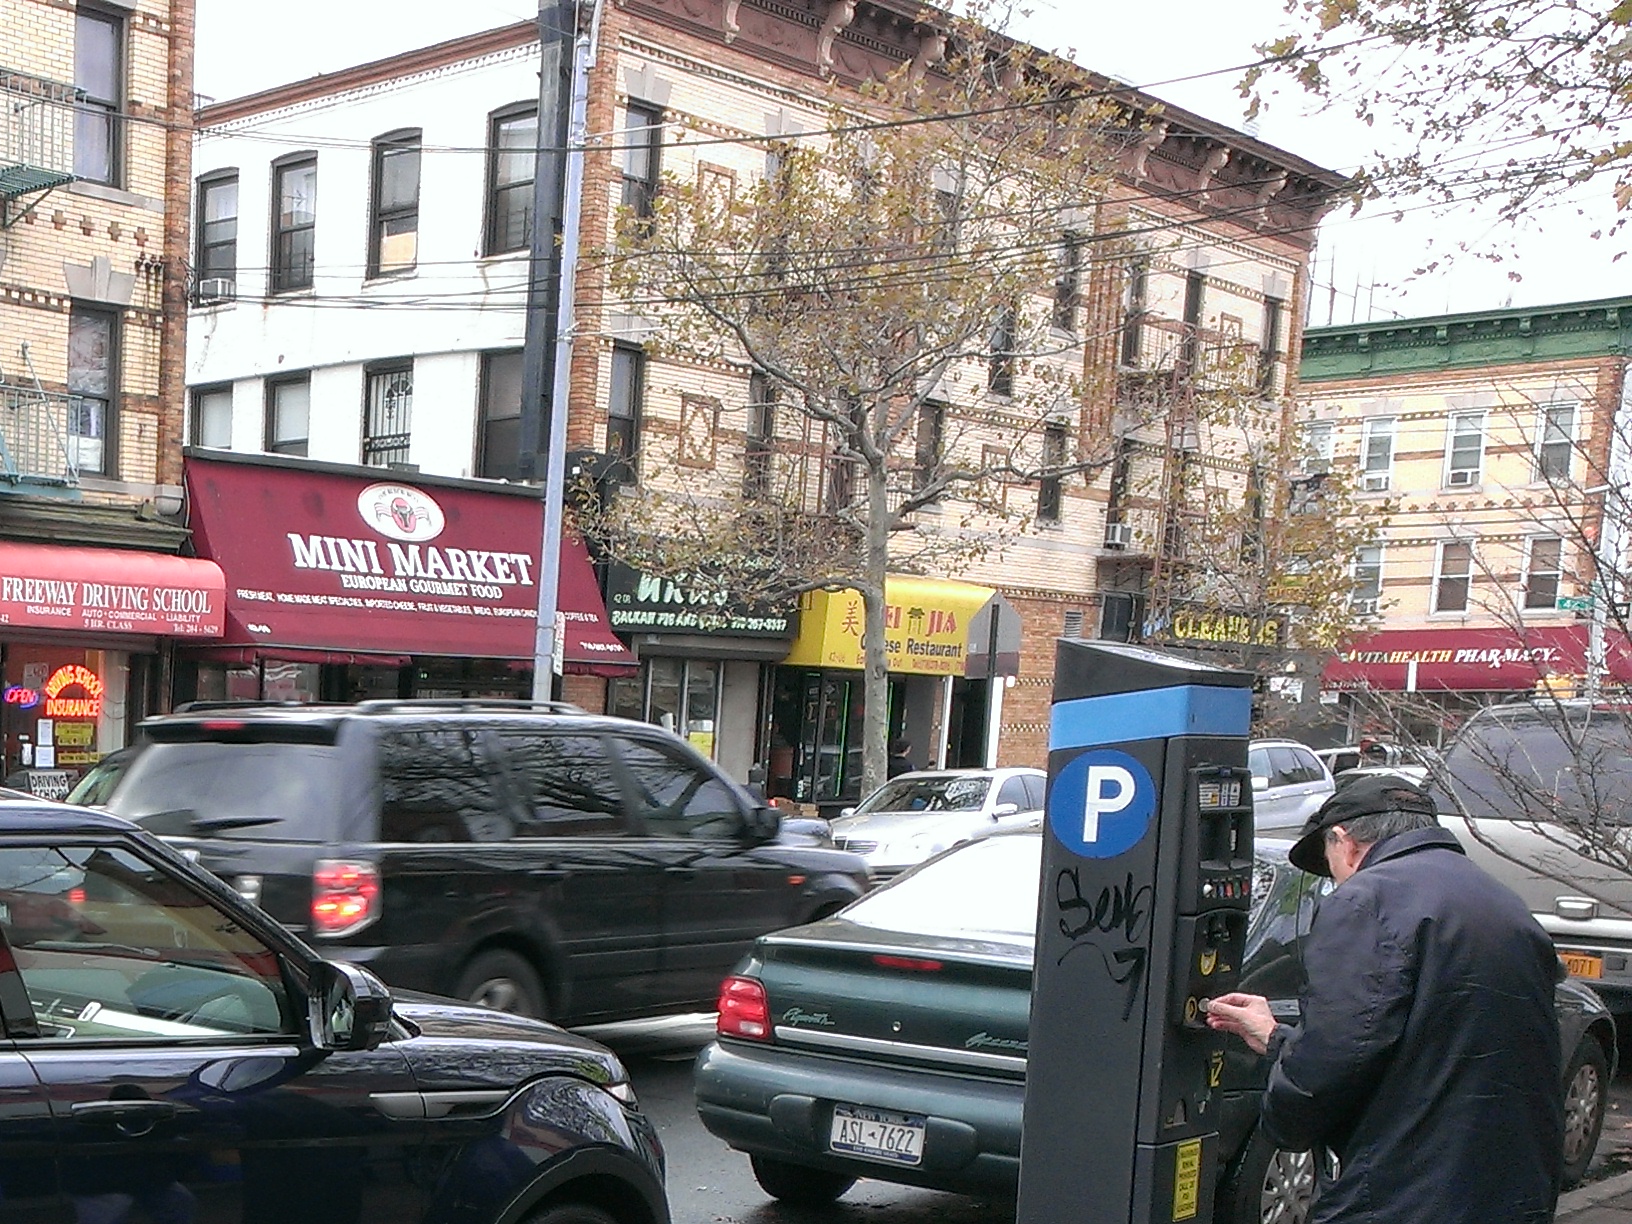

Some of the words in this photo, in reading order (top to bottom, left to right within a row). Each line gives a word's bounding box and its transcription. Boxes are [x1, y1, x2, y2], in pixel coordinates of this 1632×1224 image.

[286, 532, 384, 574] MINI
[385, 541, 535, 586] MARKET
[1, 576, 79, 607] FREEWAY
[81, 582, 149, 611] DRIVING
[152, 588, 212, 614] SCHOOL
[341, 574, 408, 594] EUROPEAN
[408, 577, 468, 598] GOURMET
[469, 582, 504, 600] FOOD
[26, 605, 72, 617] INSURANCE
[81, 608, 103, 618] AUTO
[108, 611, 157, 622] COMMERCIAL
[165, 613, 201, 624] LIABILITY
[611, 610, 655, 626] BALKAN
[883, 605, 903, 629] EI
[925, 610, 957, 637] JIA
[106, 620, 133, 630] CLASS
[906, 637, 963, 657] Restaurant
[1356, 649, 1454, 664] VITAHEALTH
[45, 665, 75, 699] DRIVING
[75, 664, 104, 699] SCHOOL
[5, 687, 36, 704] OPEN
[45, 698, 101, 716] INSURANCE
[30, 774, 68, 787] DRIVING
[1081, 765, 1136, 843] P
